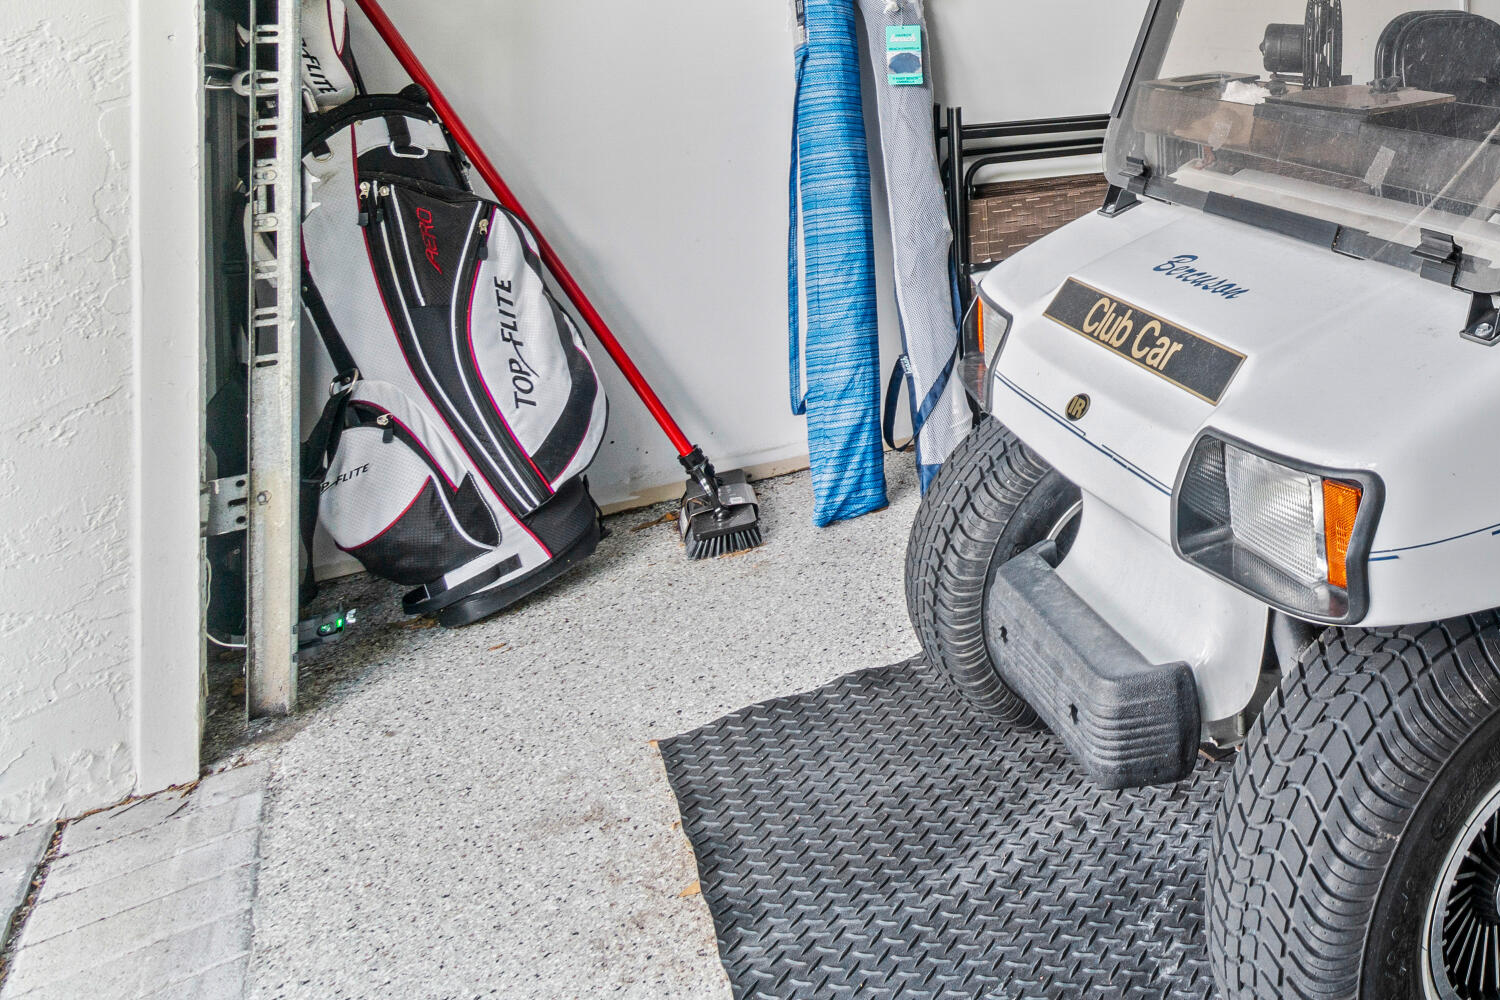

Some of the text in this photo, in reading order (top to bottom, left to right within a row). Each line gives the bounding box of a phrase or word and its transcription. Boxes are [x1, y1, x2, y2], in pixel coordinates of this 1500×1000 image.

[416, 207, 442, 275] AERO
[1082, 297, 1184, 371] Club Car
[508, 358, 537, 409] TOP
[1067, 395, 1086, 419] IR
